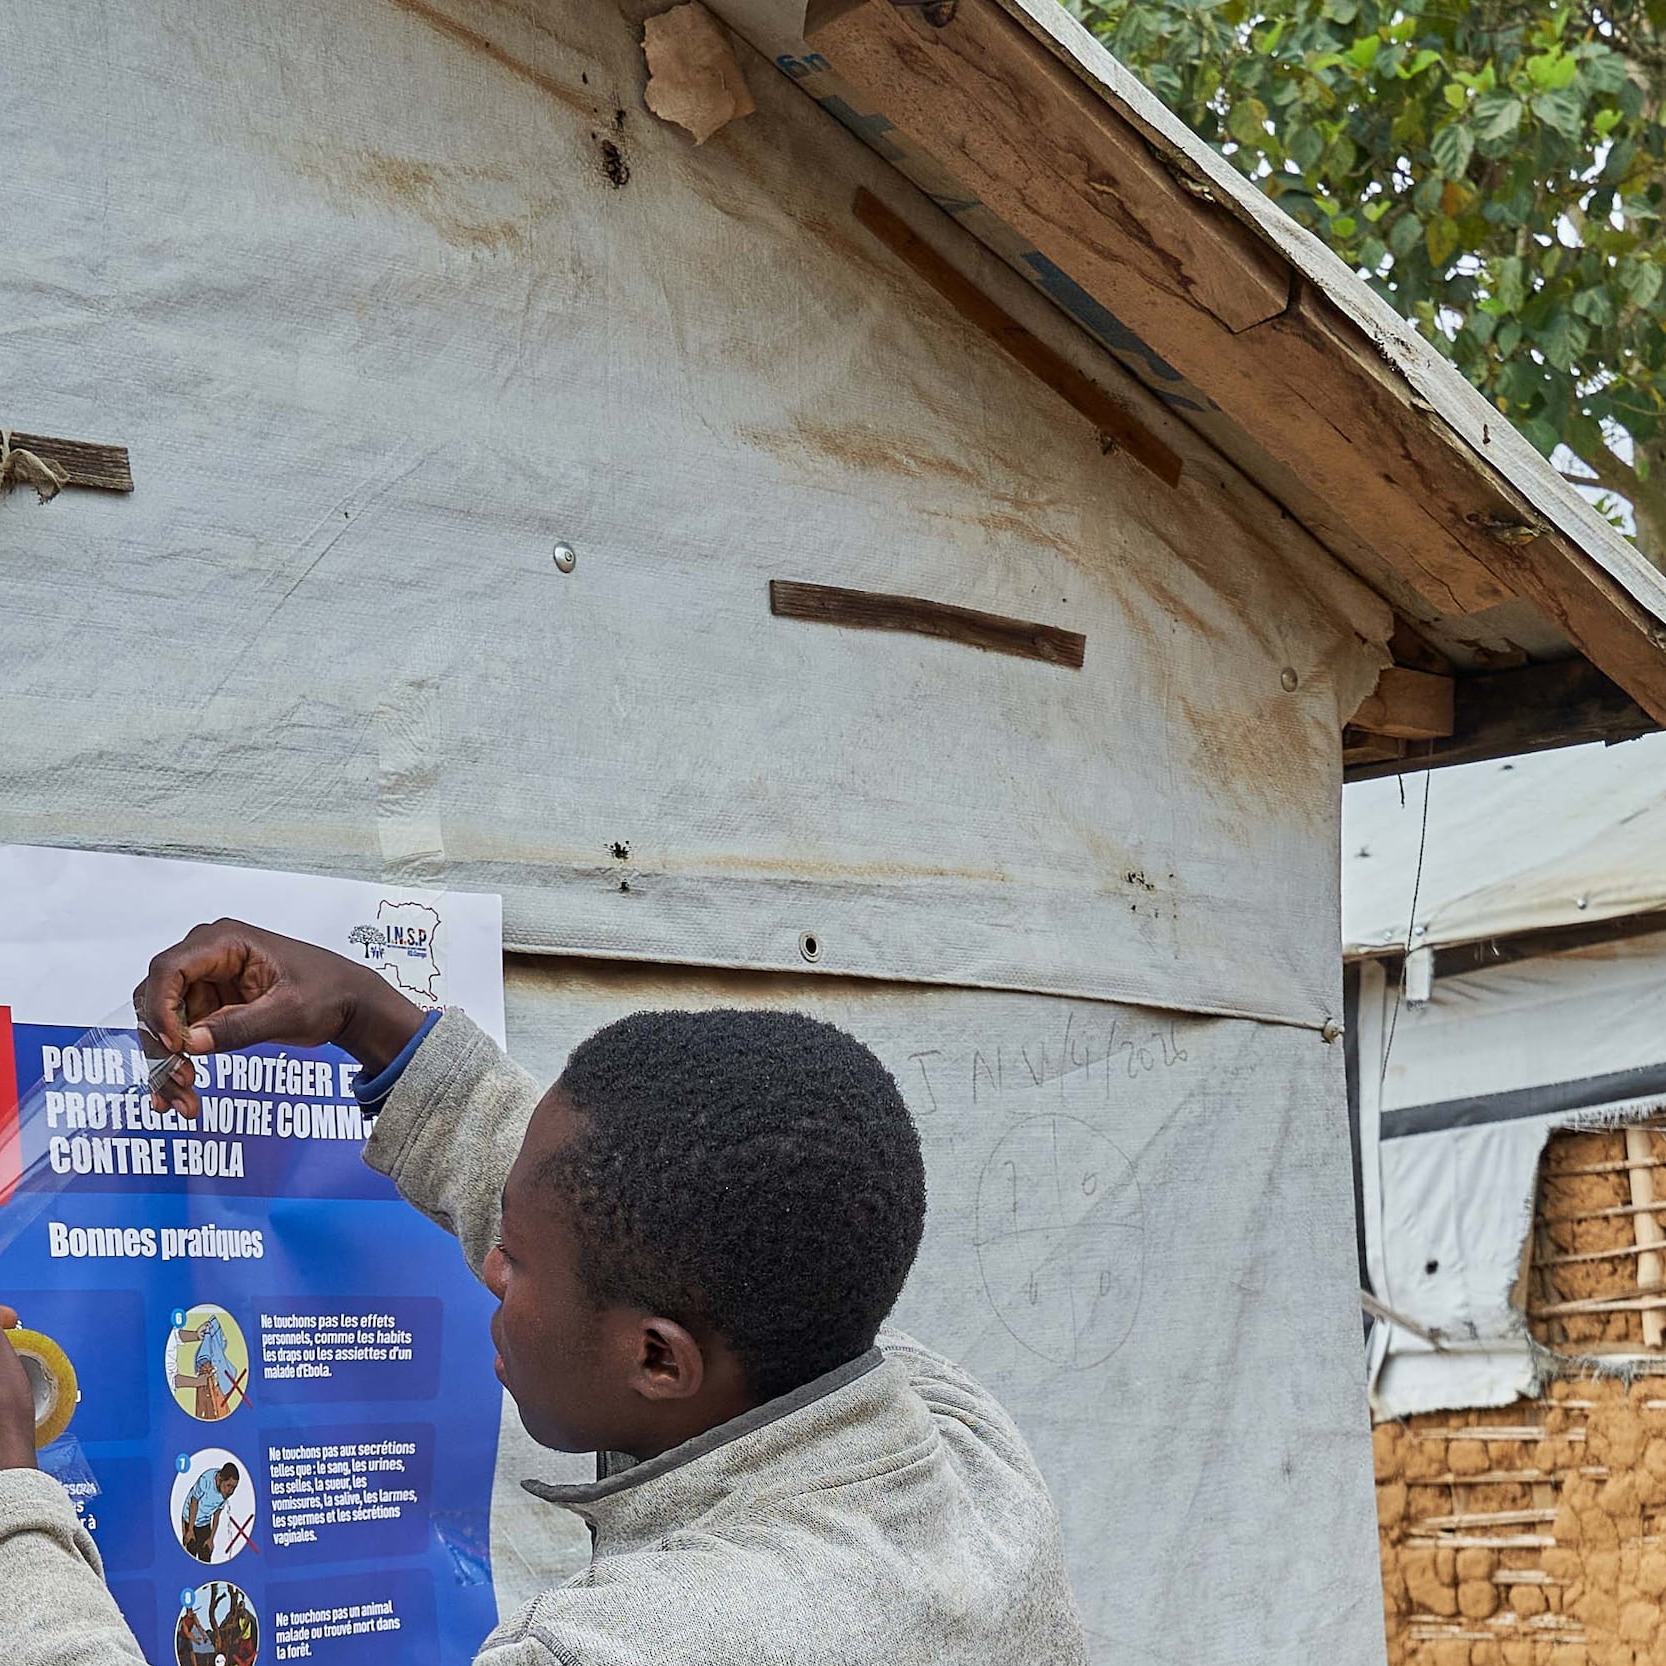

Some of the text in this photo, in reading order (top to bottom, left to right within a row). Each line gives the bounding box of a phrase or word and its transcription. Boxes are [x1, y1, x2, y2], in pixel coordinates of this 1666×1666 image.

[42, 1045, 127, 1086] POUR
[131, 1048, 210, 1089] NS
[216, 1053, 333, 1098] PROTÉGER
[202, 1096, 273, 1136] NOTRE
[49, 1136, 244, 1178] CONTRE EBOLA
[49, 1221, 264, 1261] Bonnes pratiques
[261, 1313, 396, 1330] Ne touchons pas les effets
[262, 1330, 413, 1347] personnels, comme les habits
[263, 1346, 413, 1364] les draps ou les assiettes d'un
[264, 1363, 333, 1379] malade d'Ebola.
[269, 1440, 416, 1461] Ne touchons pas aux secrétions
[270, 1457, 406, 1479] telles que le sang, les urines,
[270, 1474, 368, 1495] les selles, la sueur, les
[271, 1488, 418, 1512] vomissures, la salive, les larmes,
[272, 1504, 401, 1530] les spermes et les sécrétions
[272, 1528, 318, 1547] vaginales.
[276, 1600, 394, 1627] Ne touchons pas un animal
[276, 1617, 401, 1643] malade ou trouvé mort dans
[276, 1642, 313, 1660] la forêt.
